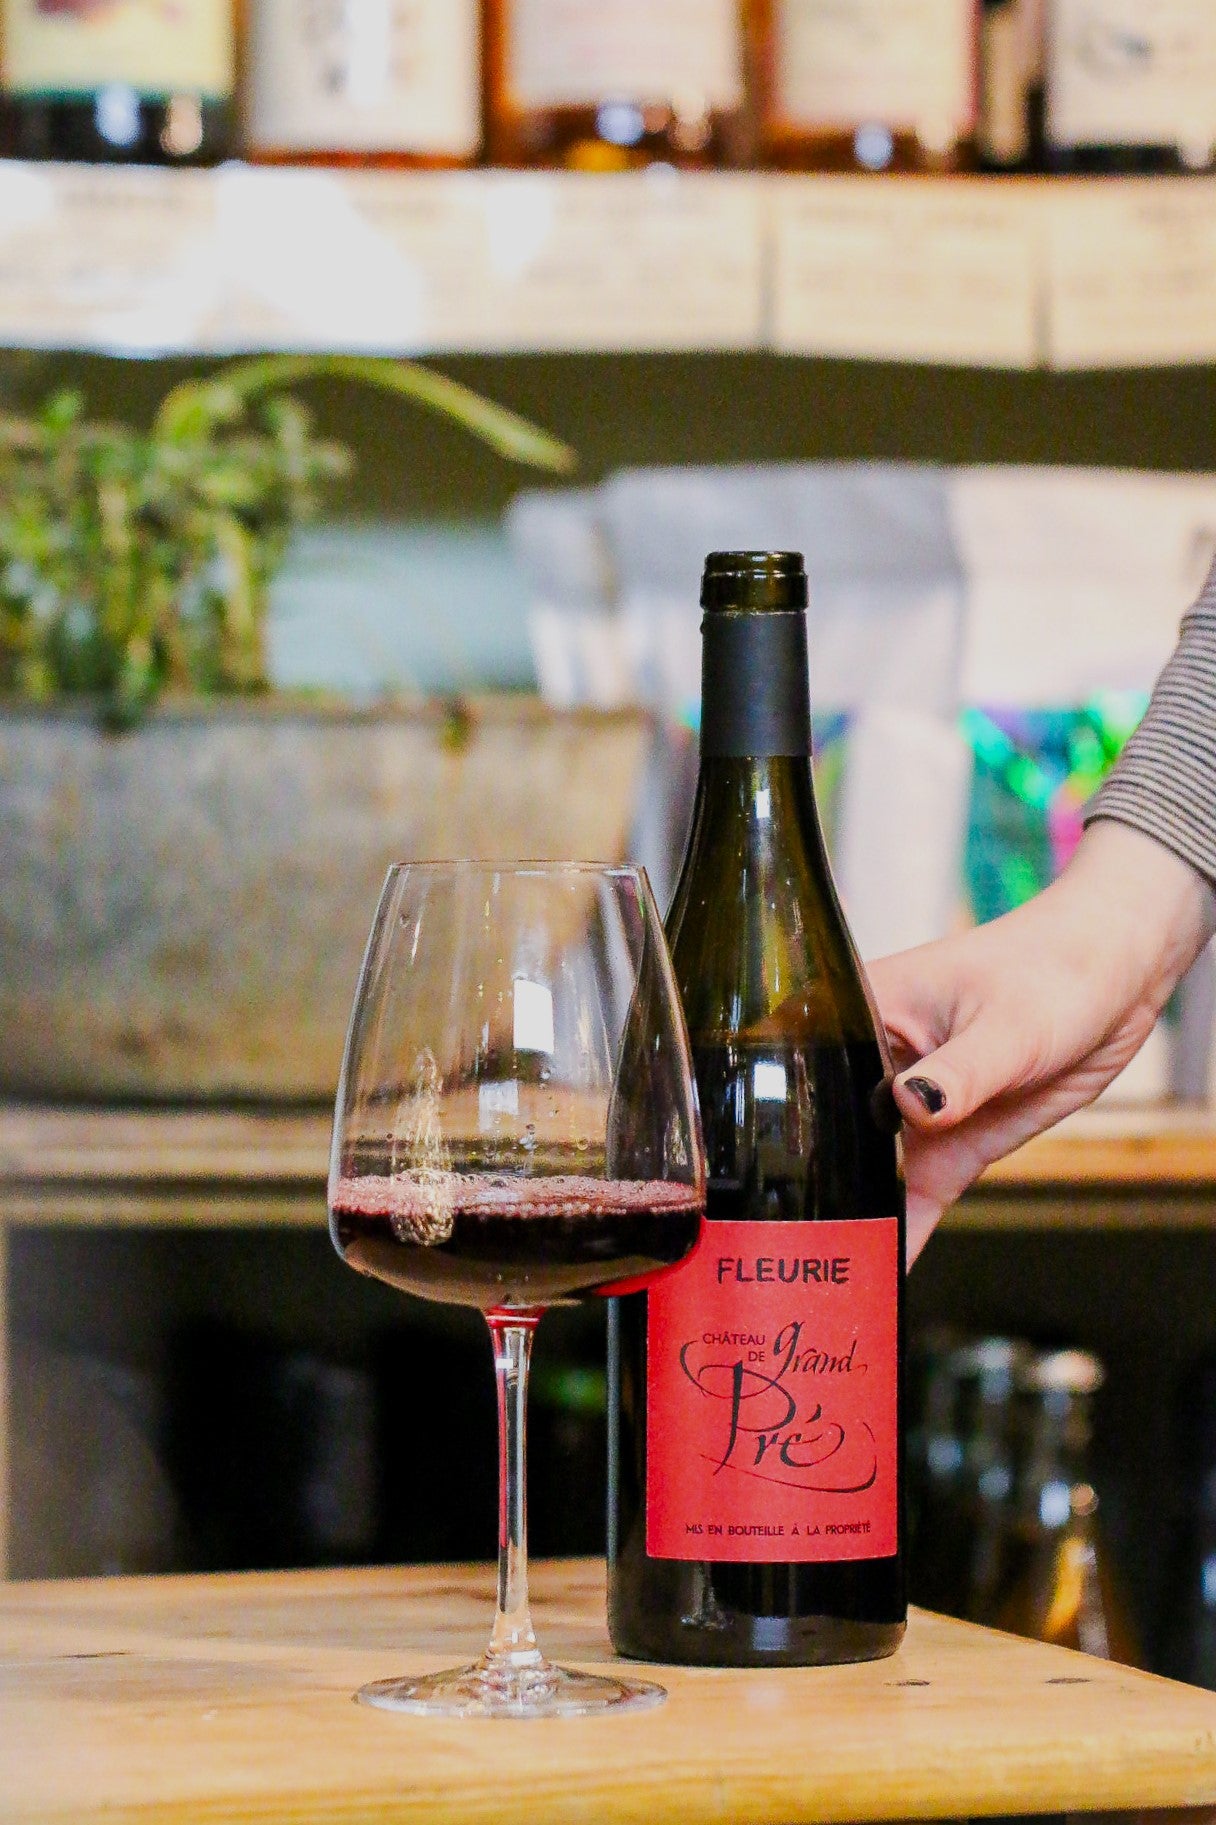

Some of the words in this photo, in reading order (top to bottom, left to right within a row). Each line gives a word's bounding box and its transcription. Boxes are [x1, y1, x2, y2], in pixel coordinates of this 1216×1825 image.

[717, 1257, 850, 1285] FLEURIE
[702, 1331, 766, 1346] CHÂTEAU
[748, 1350, 765, 1363] DE
[698, 1360, 845, 1476] Pré
[685, 1523, 703, 1535] MIS
[708, 1524, 723, 1536] EN
[728, 1525, 785, 1537] BOUTEILLE
[791, 1523, 800, 1536] À
[806, 1525, 821, 1536] LA
